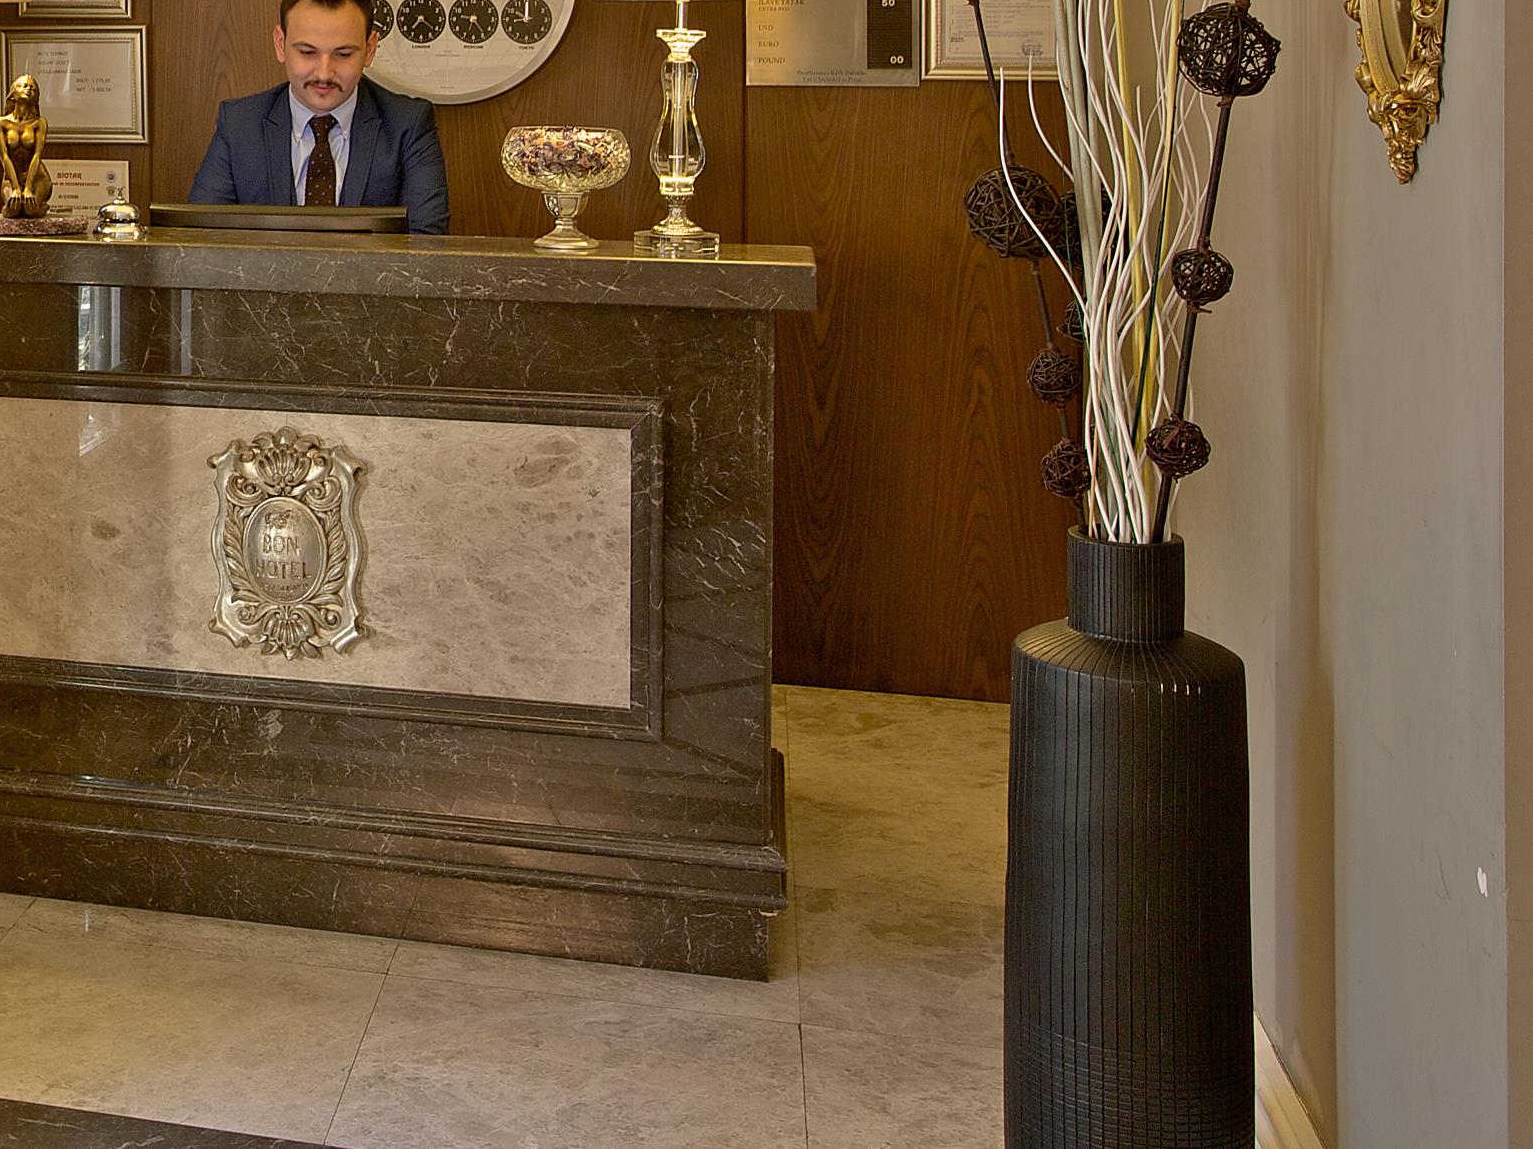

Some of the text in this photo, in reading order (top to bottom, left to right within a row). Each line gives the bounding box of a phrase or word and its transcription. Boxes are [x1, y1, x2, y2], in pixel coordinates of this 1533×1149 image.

[890, 56, 904, 64] 00
[262, 534, 300, 556] BON
[256, 559, 312, 579] HOTEL
